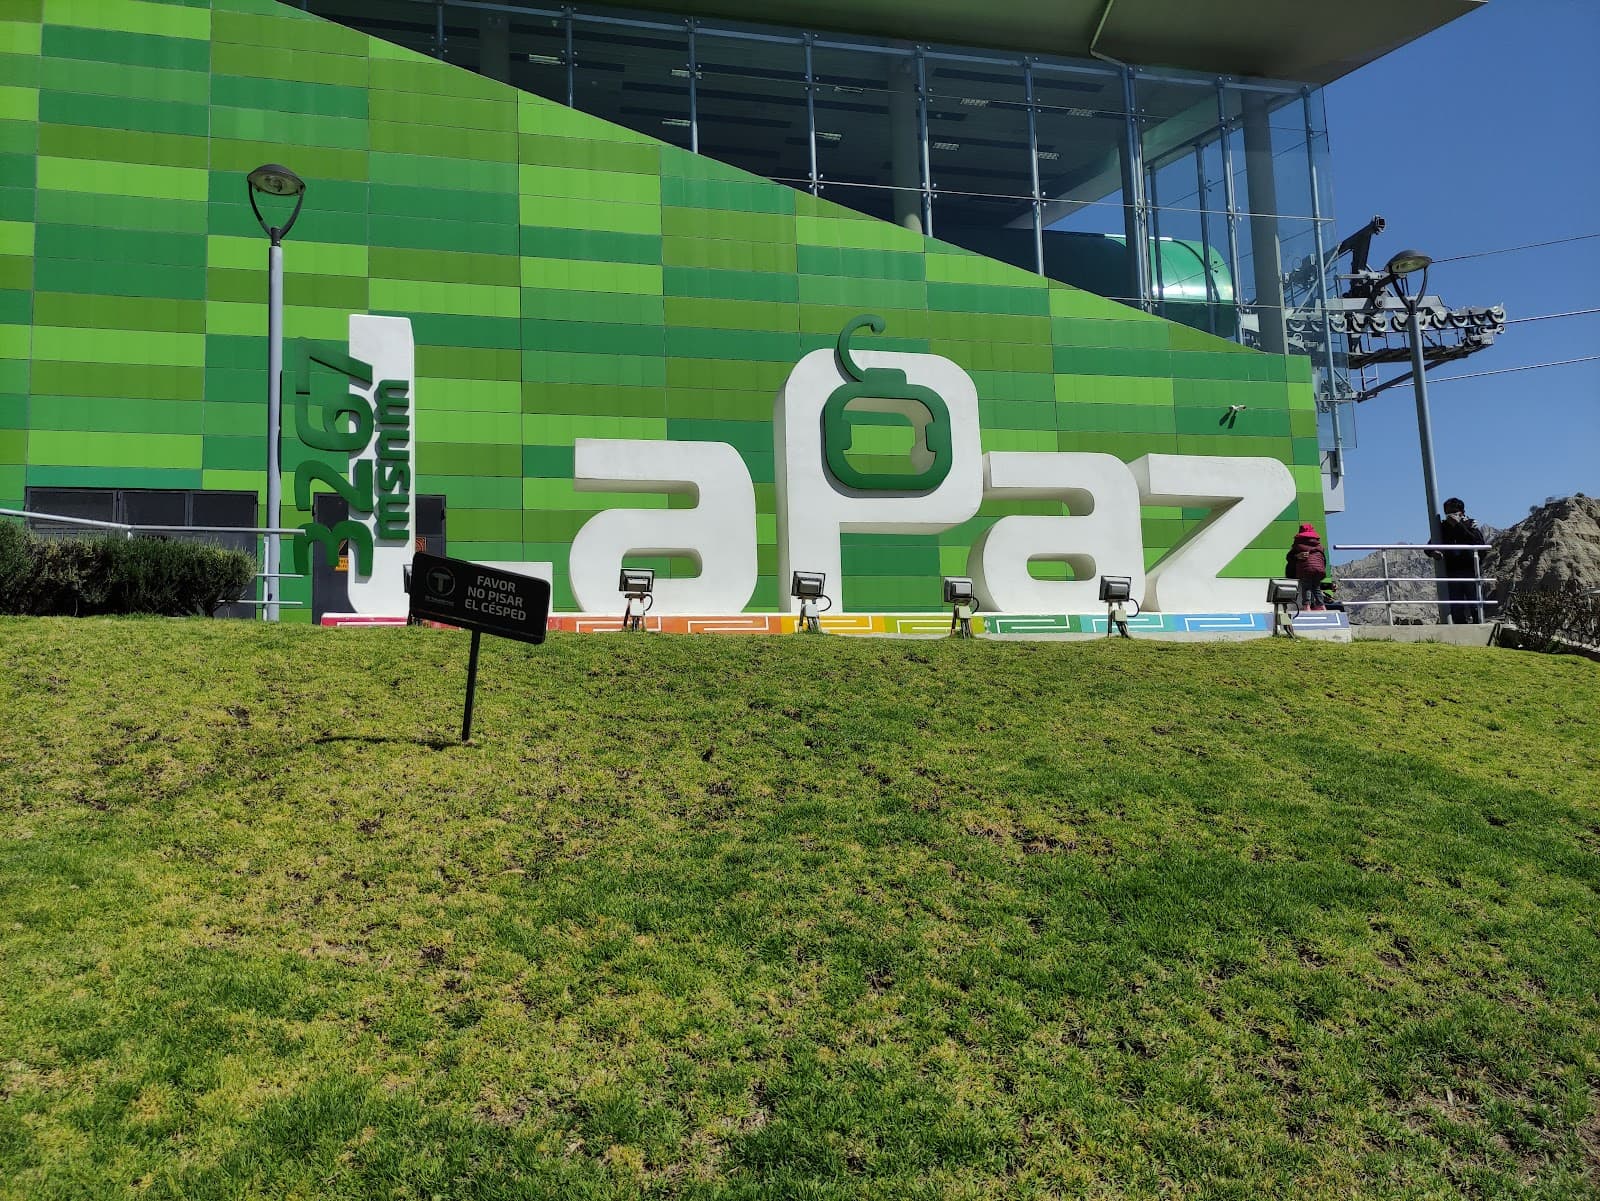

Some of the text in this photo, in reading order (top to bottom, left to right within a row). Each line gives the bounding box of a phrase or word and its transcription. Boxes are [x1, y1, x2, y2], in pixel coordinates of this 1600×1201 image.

[293, 337, 374, 577] 3267
[376, 379, 410, 542] msnm
[477, 575, 516, 593] FAVOR
[467, 586, 523, 608] NO PISAR
[464, 599, 479, 611] EL
[481, 601, 527, 621] CÉSPED
